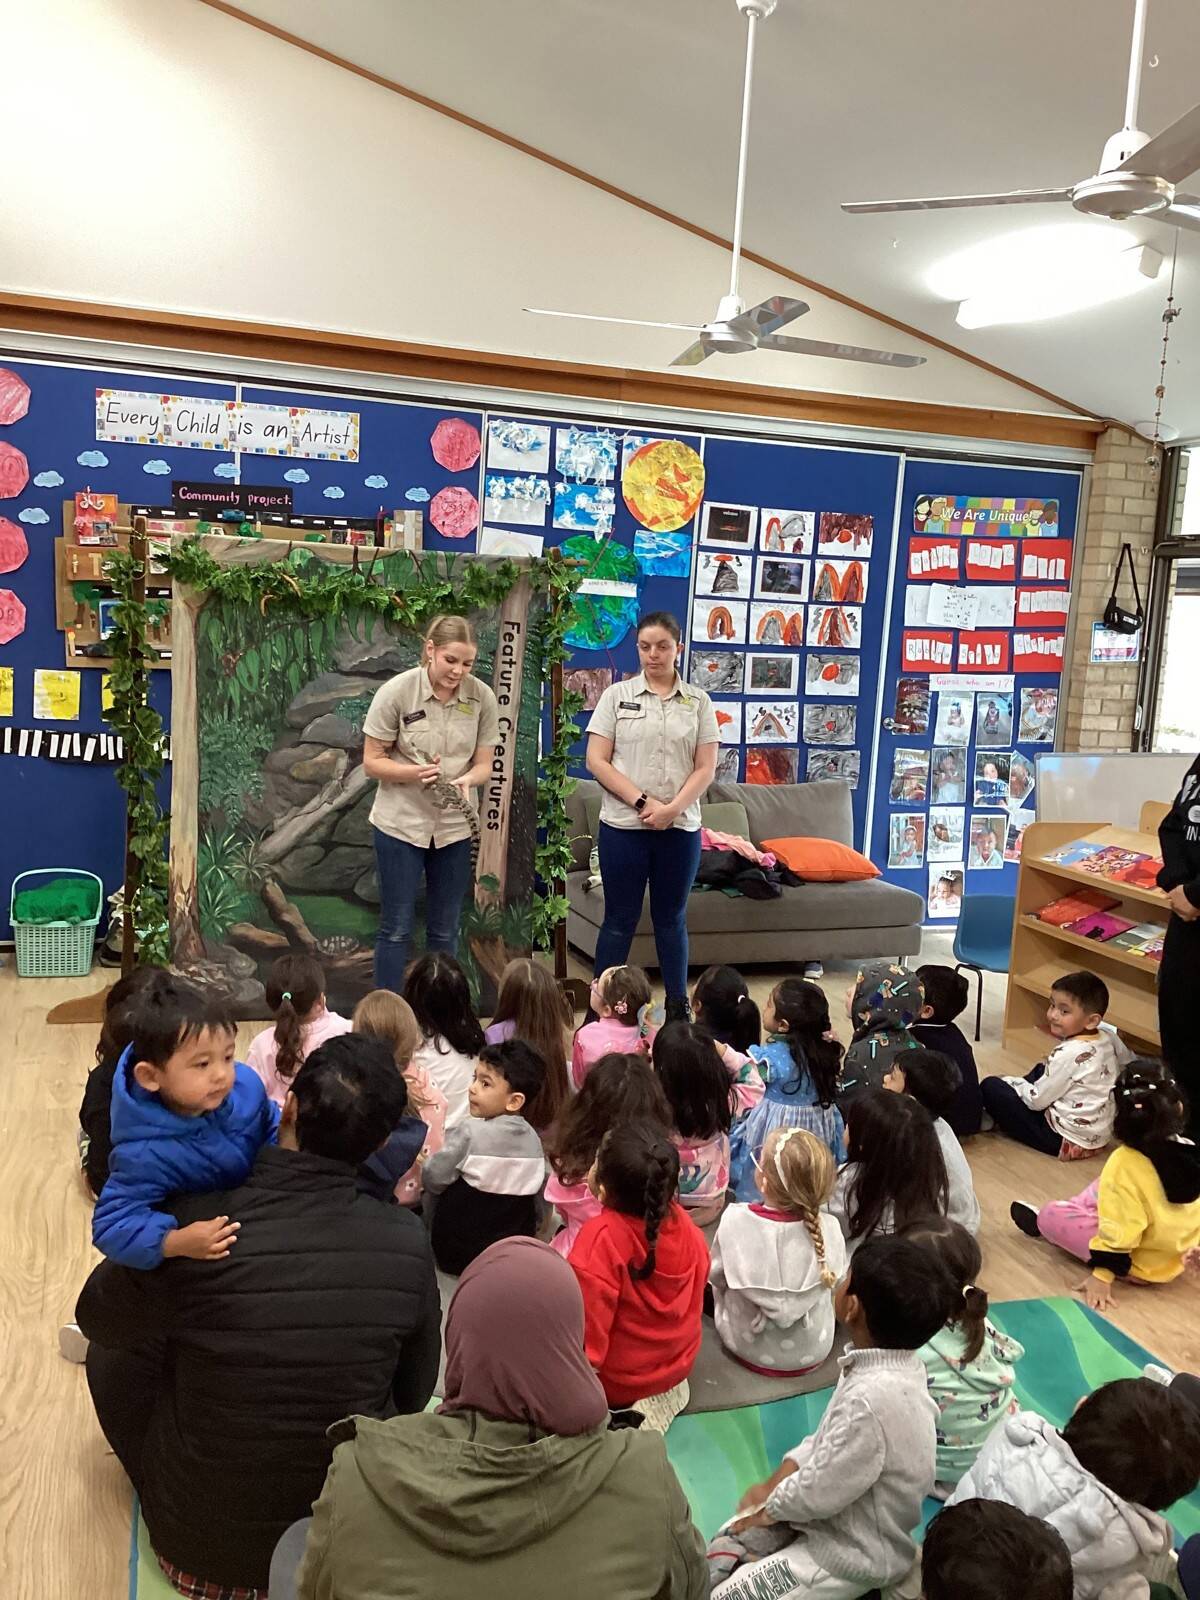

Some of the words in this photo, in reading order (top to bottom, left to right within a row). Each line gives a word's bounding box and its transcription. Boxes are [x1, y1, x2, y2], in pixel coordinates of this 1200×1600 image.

[106, 401, 160, 436] Every
[176, 409, 221, 435] Child
[237, 415, 254, 436] is
[263, 423, 288, 439] an
[301, 421, 351, 446] Artist
[178, 486, 240, 505] Community
[940, 507, 960, 521] We
[963, 508, 986, 521] Are
[498, 620, 521, 706] Feature
[487, 717, 512, 832] Creatures
